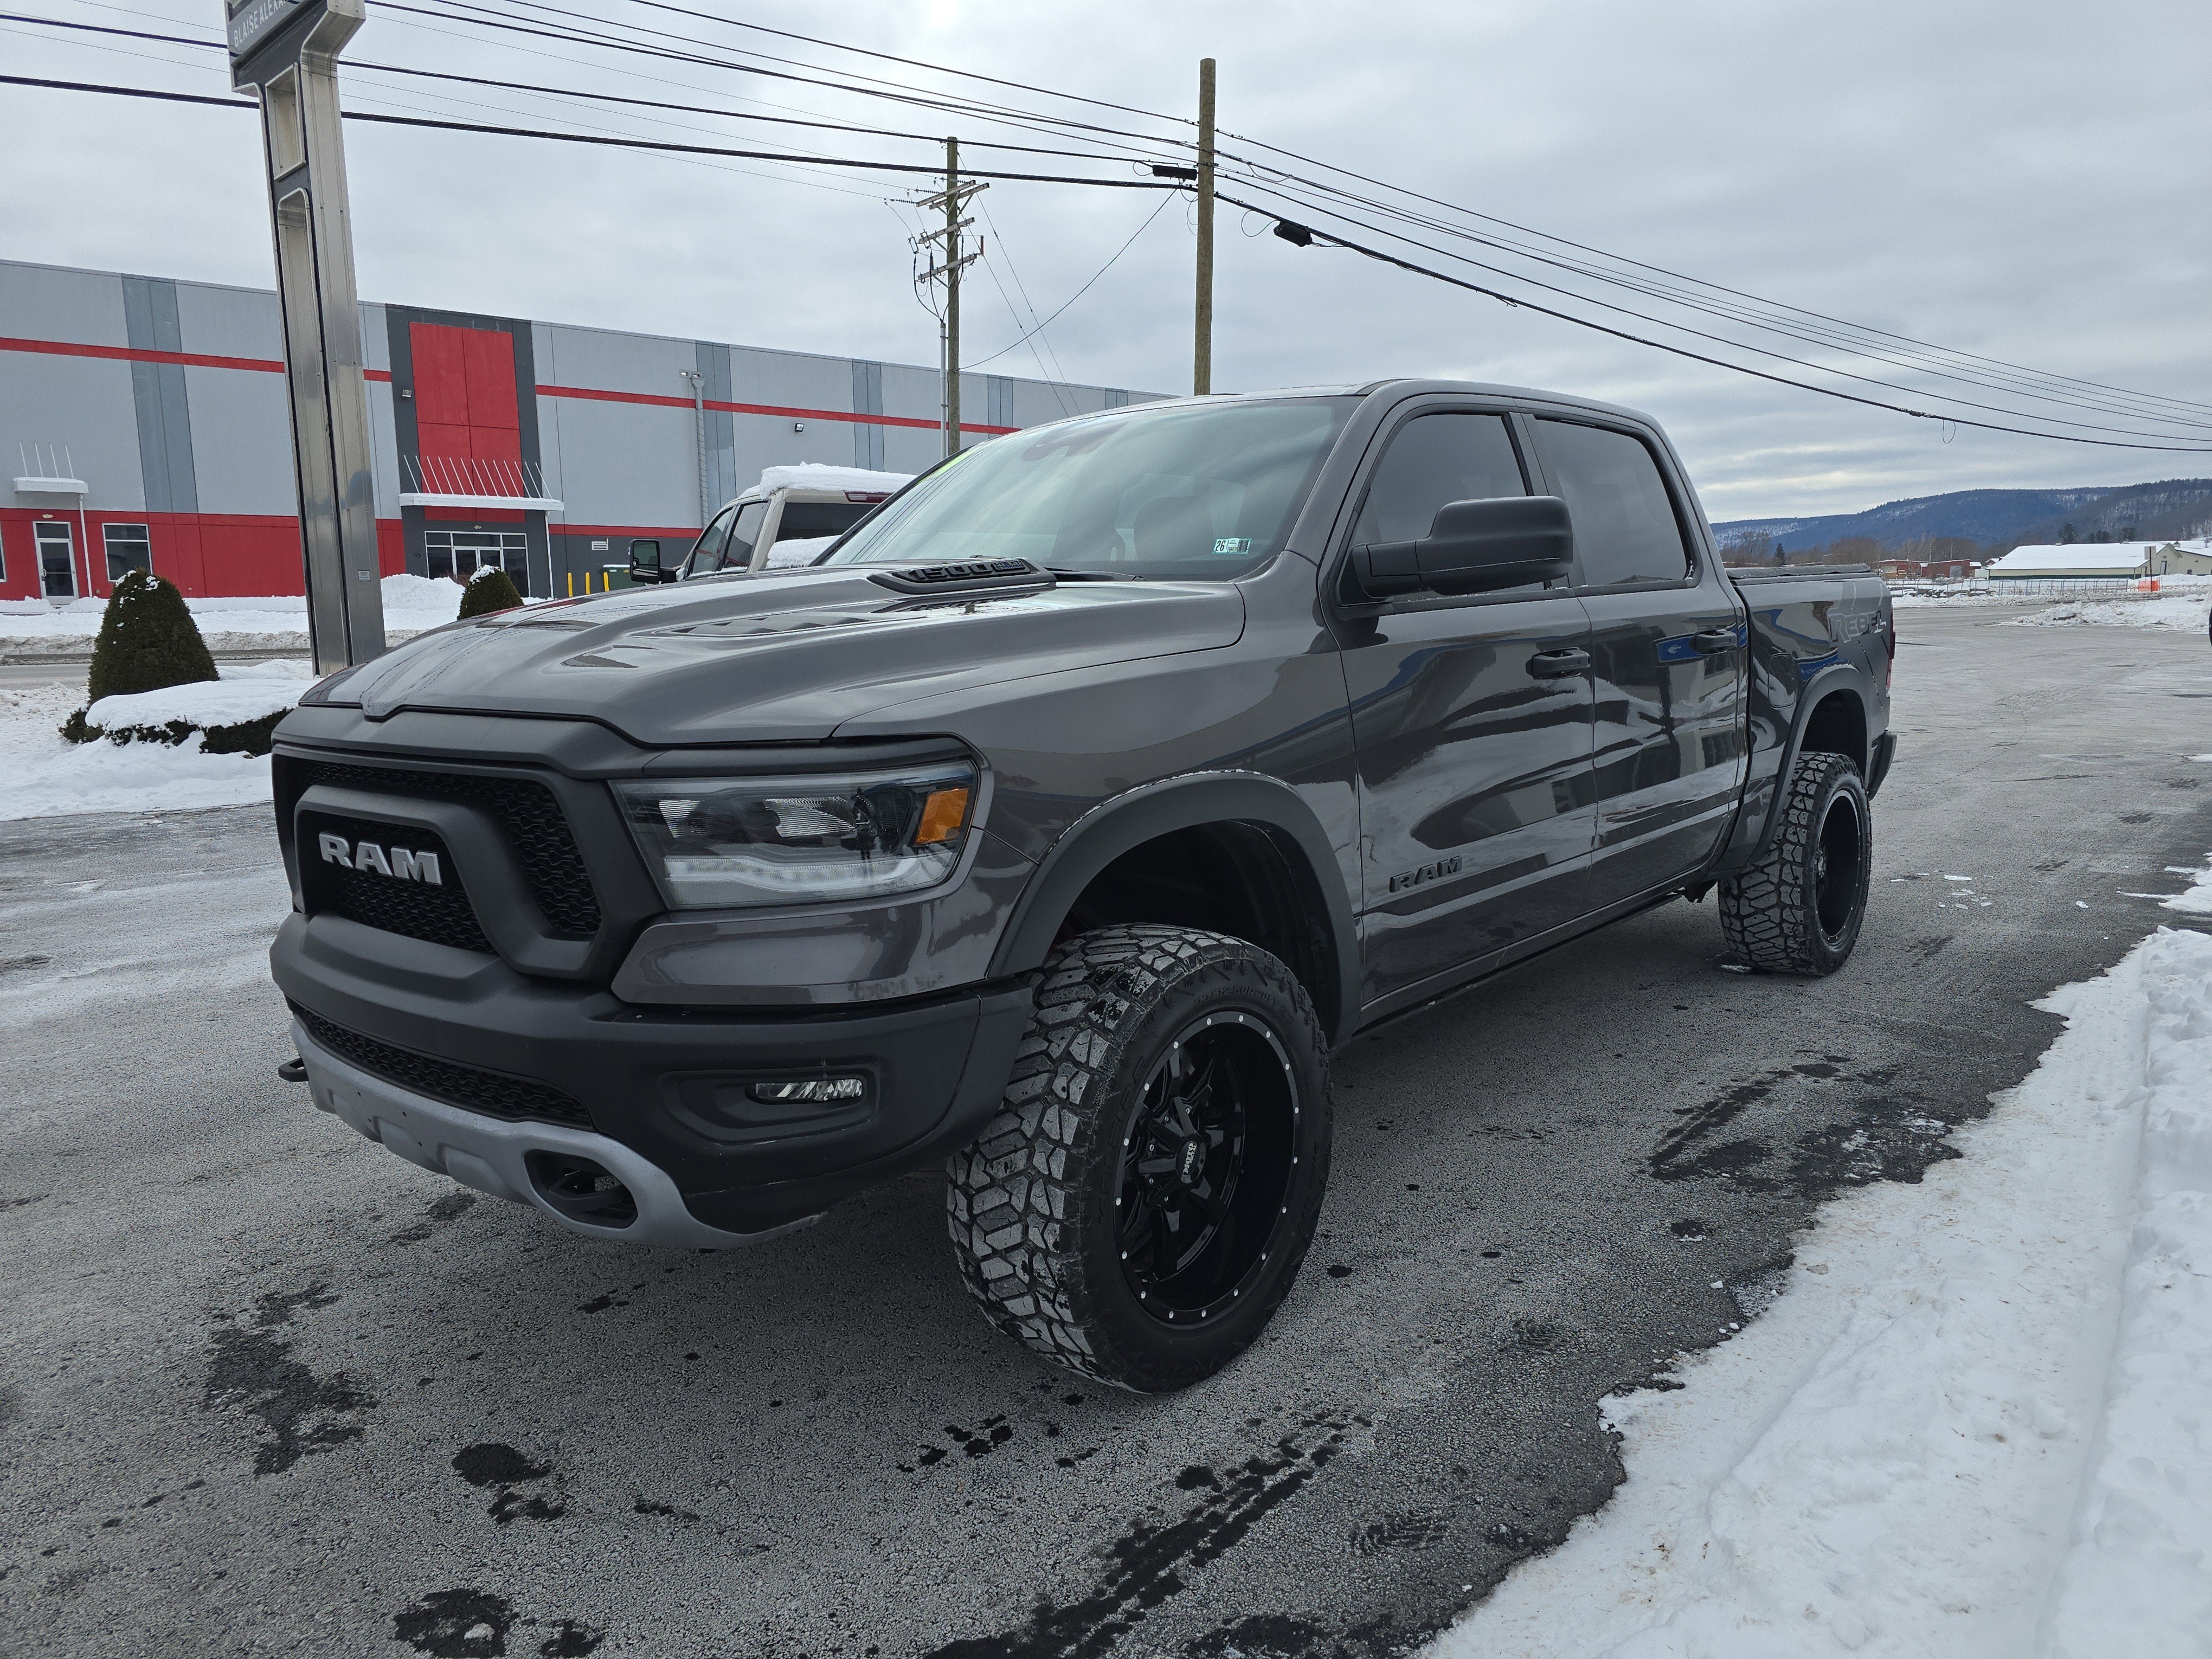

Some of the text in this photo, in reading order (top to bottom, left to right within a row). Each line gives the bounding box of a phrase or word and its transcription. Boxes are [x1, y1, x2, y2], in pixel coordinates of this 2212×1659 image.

[234, 10, 259, 47] BLAISE
[1216, 540, 1225, 551] 26
[909, 562, 993, 580] 1500
[1827, 610, 1886, 644] REBEL
[319, 831, 442, 886] RAM
[1388, 855, 1463, 893] RAM
[1182, 1142, 1195, 1174] MOTO
